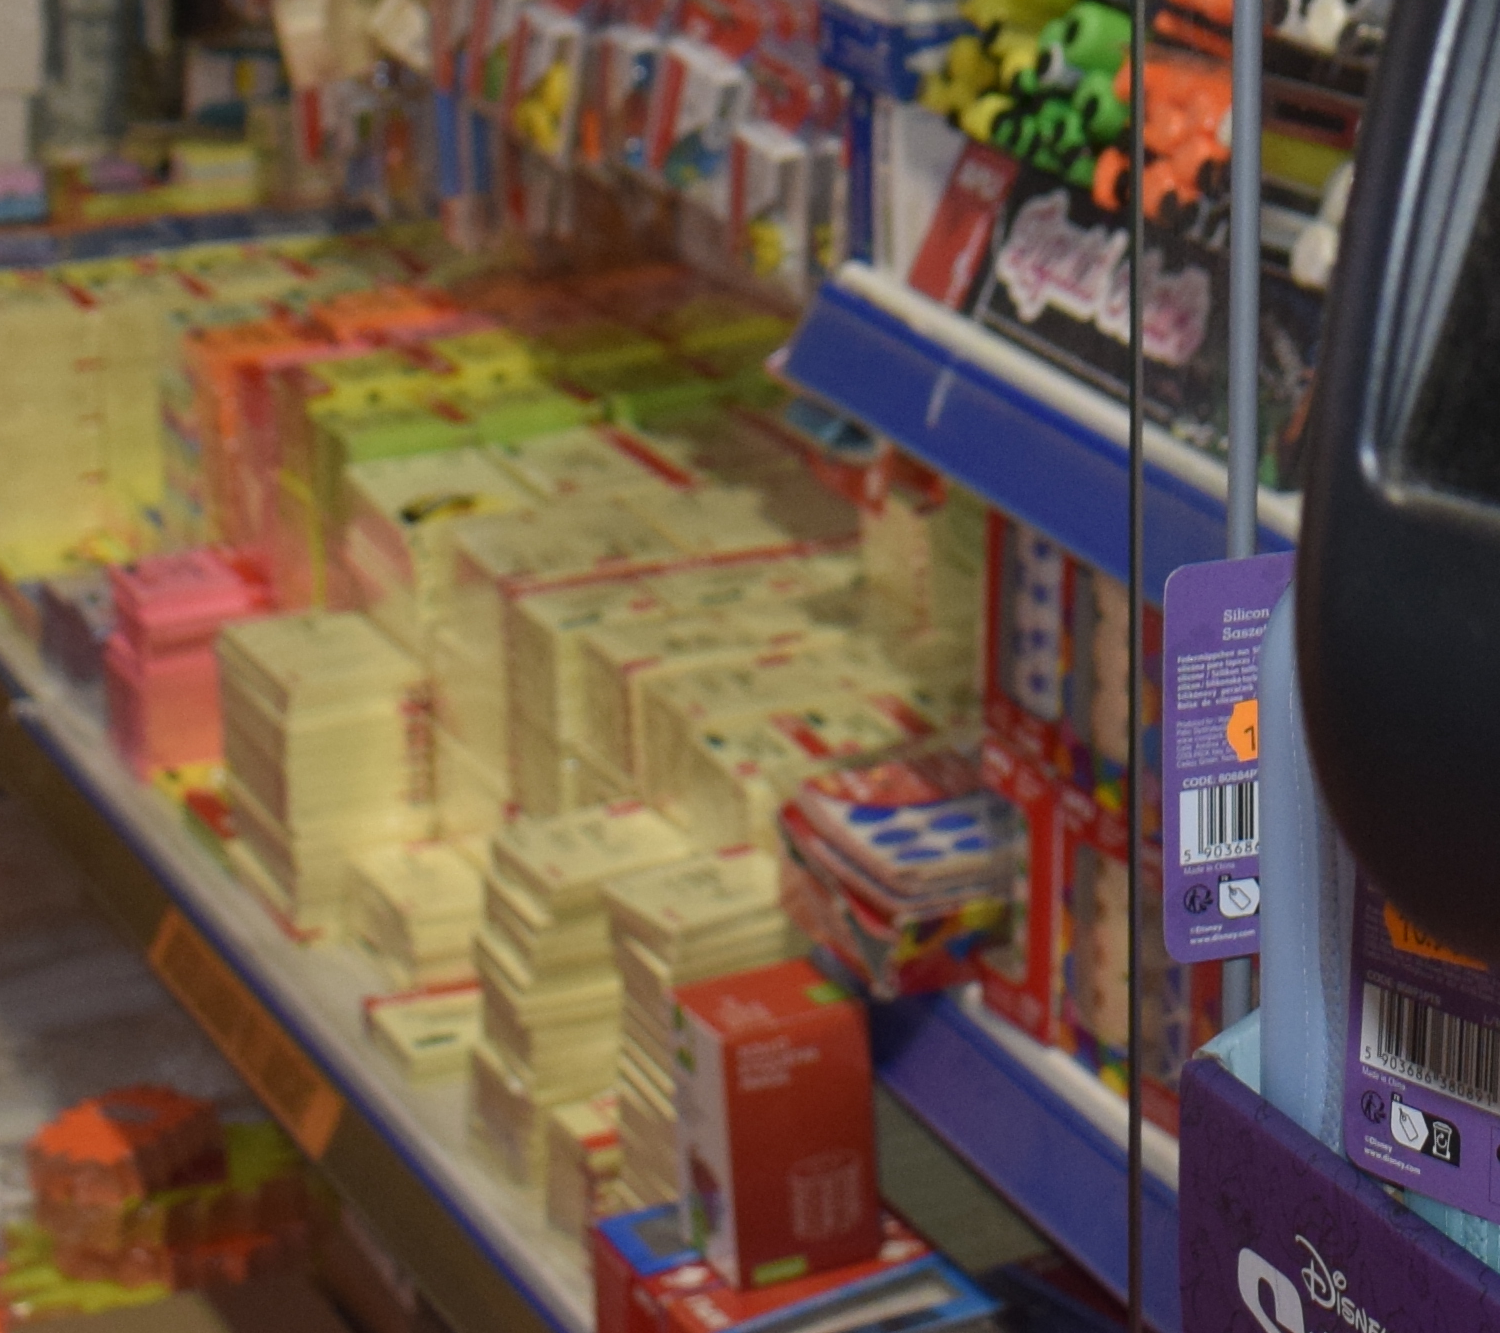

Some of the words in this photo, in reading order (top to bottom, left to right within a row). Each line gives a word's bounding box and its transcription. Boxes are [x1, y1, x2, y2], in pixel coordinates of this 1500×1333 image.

[1223, 607, 1269, 623] Silicon
[1184, 849, 1191, 862] 5
[1365, 1046, 1371, 1060] 5
[1381, 1052, 1433, 1084] 903686
[1362, 1066, 1380, 1080] Made
[1388, 1077, 1406, 1091] China
[1364, 1146, 1421, 1175] www.disney.com
